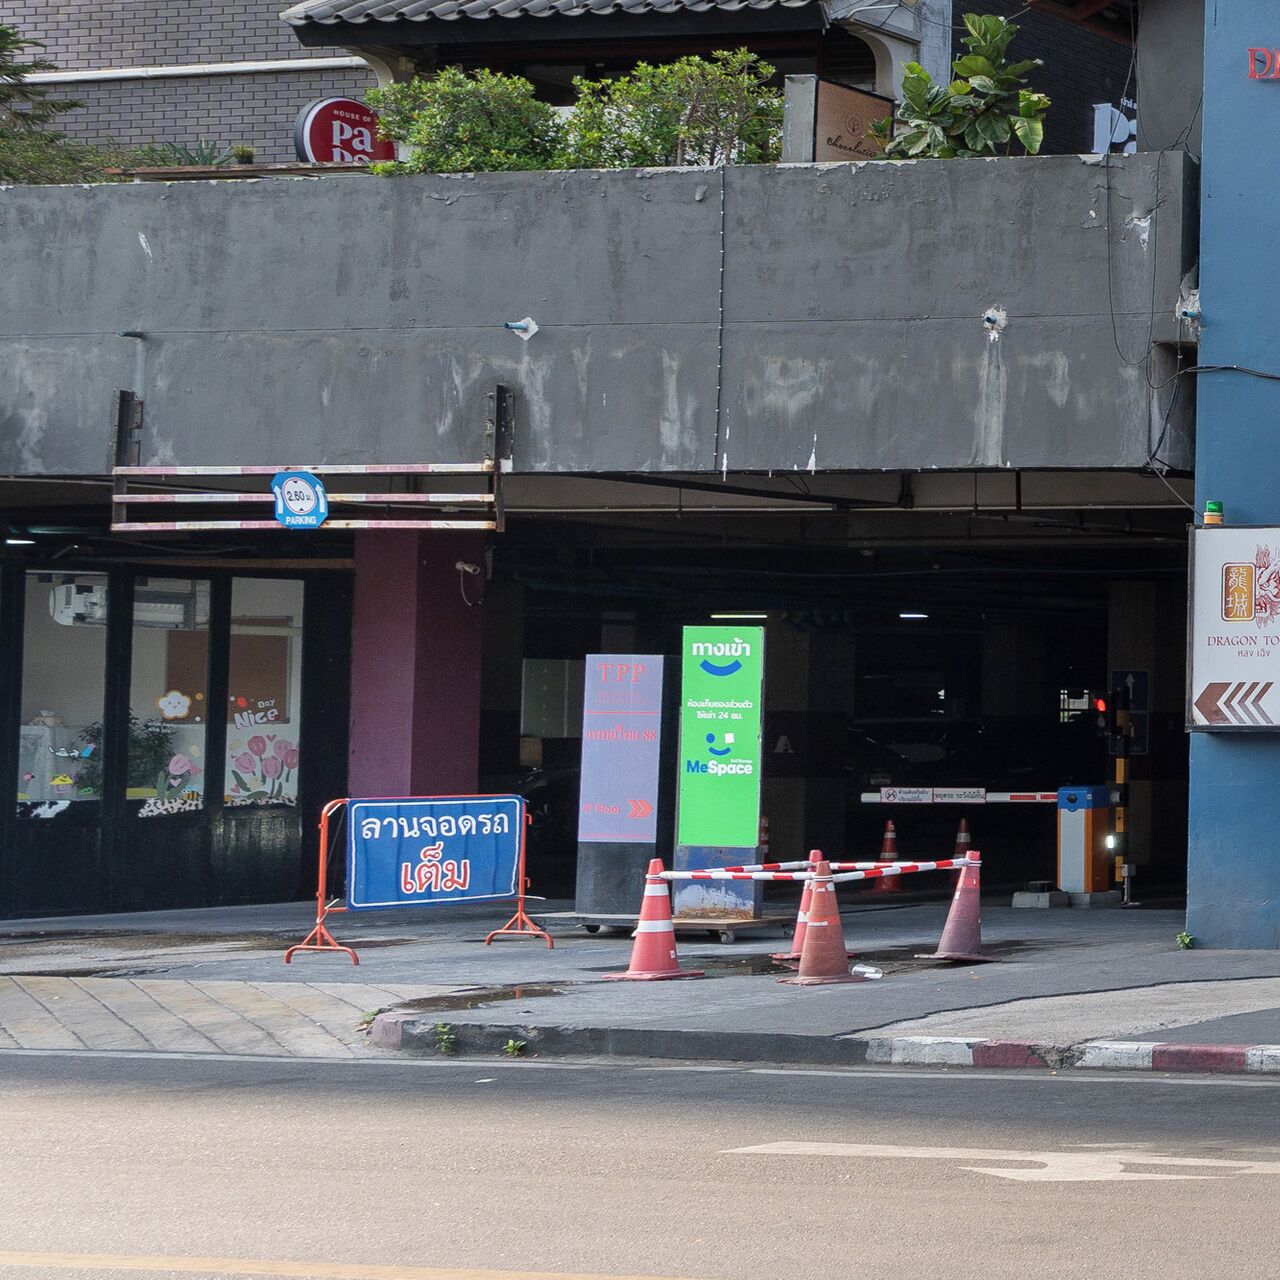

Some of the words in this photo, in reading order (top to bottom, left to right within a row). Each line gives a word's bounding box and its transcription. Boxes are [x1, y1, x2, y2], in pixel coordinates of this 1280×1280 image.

[333, 109, 361, 121] HOUSE
[286, 490, 305, 502] 2.60
[285, 515, 317, 525] PARKING
[692, 637, 751, 657] ทางเข้า
[1207, 636, 1258, 646] DRAGON
[597, 663, 647, 684] TPP
[234, 709, 279, 730] Nice
[718, 711, 729, 720] 24
[686, 759, 753, 777] MeSpace
[361, 813, 509, 839] ลานจอดรถ
[401, 841, 470, 894] เต็ม
